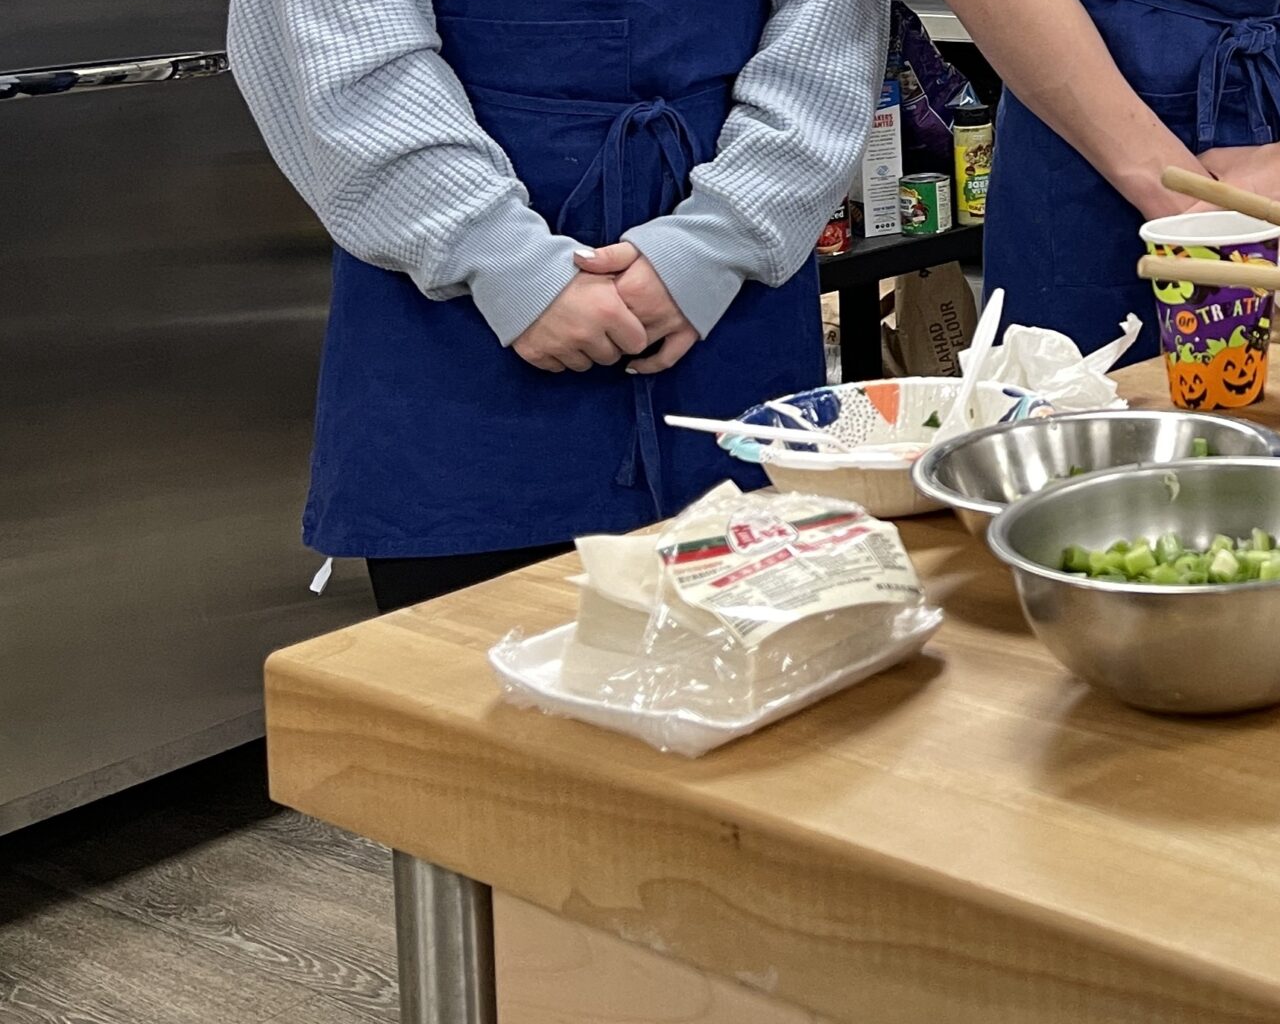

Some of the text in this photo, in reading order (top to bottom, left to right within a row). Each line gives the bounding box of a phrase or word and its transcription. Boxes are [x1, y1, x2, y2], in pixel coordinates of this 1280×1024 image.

[872, 120, 894, 128] ANTED
[939, 300, 966, 348] FLOUR
[1178, 315, 1195, 328] or
